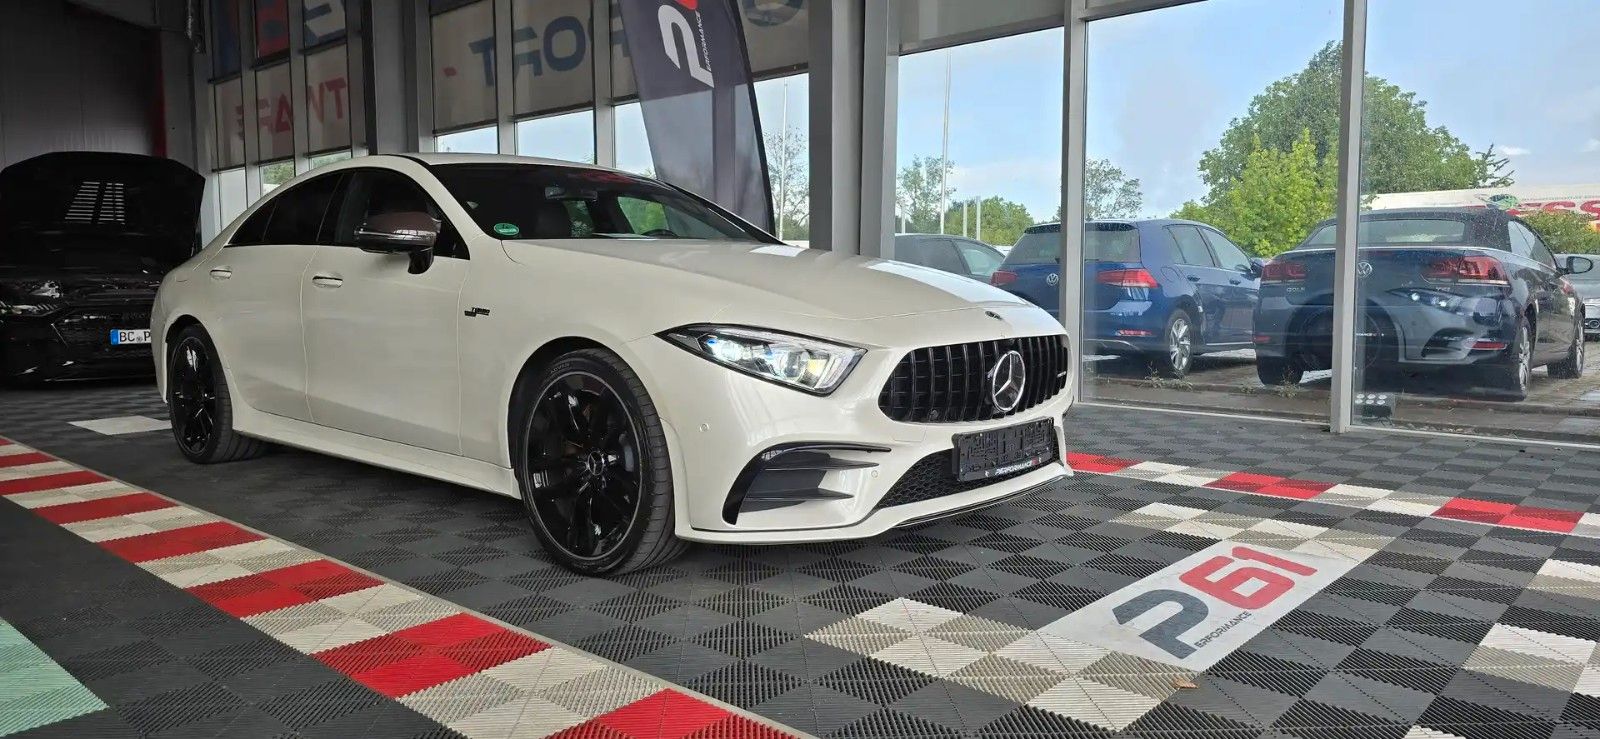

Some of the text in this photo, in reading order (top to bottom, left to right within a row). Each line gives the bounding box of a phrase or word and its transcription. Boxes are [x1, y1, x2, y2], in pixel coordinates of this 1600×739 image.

[120, 332, 135, 342] BC
[1111, 546, 1318, 660] P61
[1194, 610, 1253, 649] ERFORMANCE
